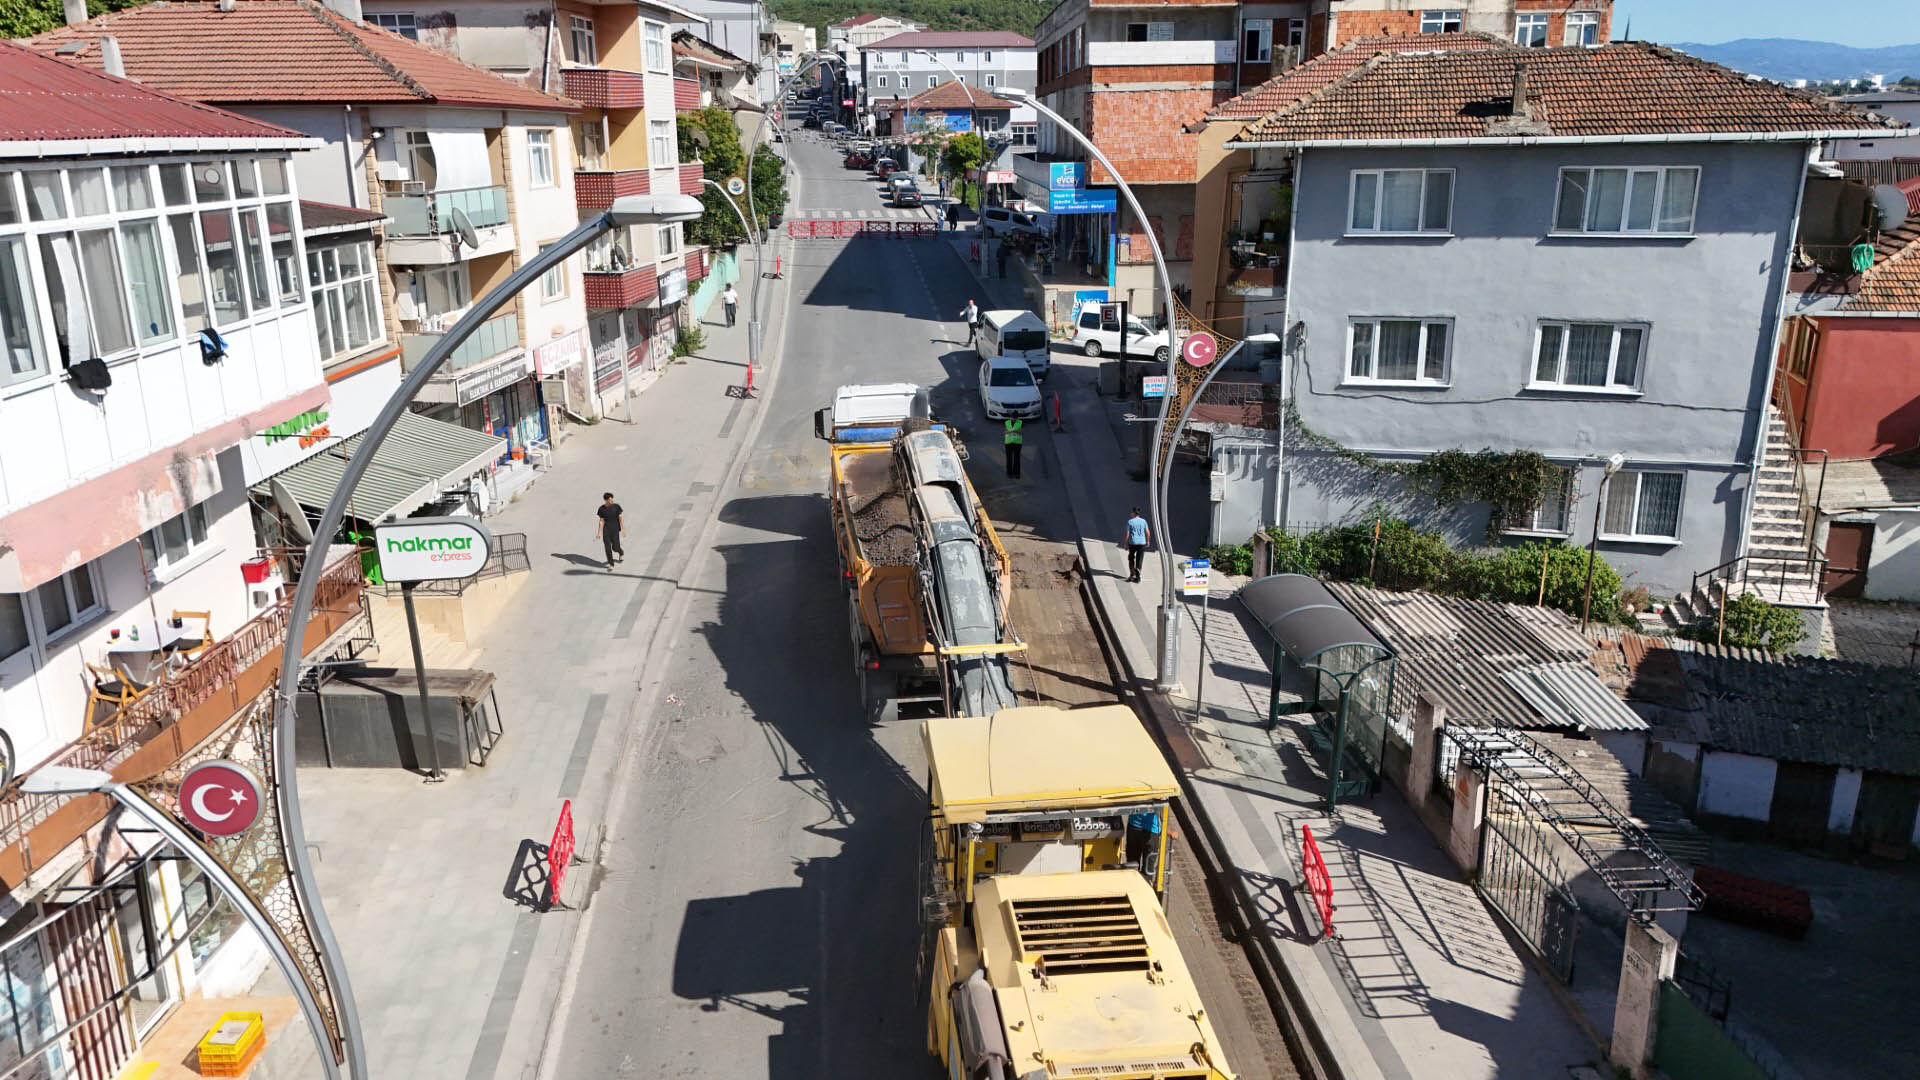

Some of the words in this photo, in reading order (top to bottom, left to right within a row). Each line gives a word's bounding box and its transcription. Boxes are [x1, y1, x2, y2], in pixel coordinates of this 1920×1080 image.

[1104, 309, 1113, 320] E
[386, 536, 472, 552] hakmar
[430, 552, 472, 562] express
